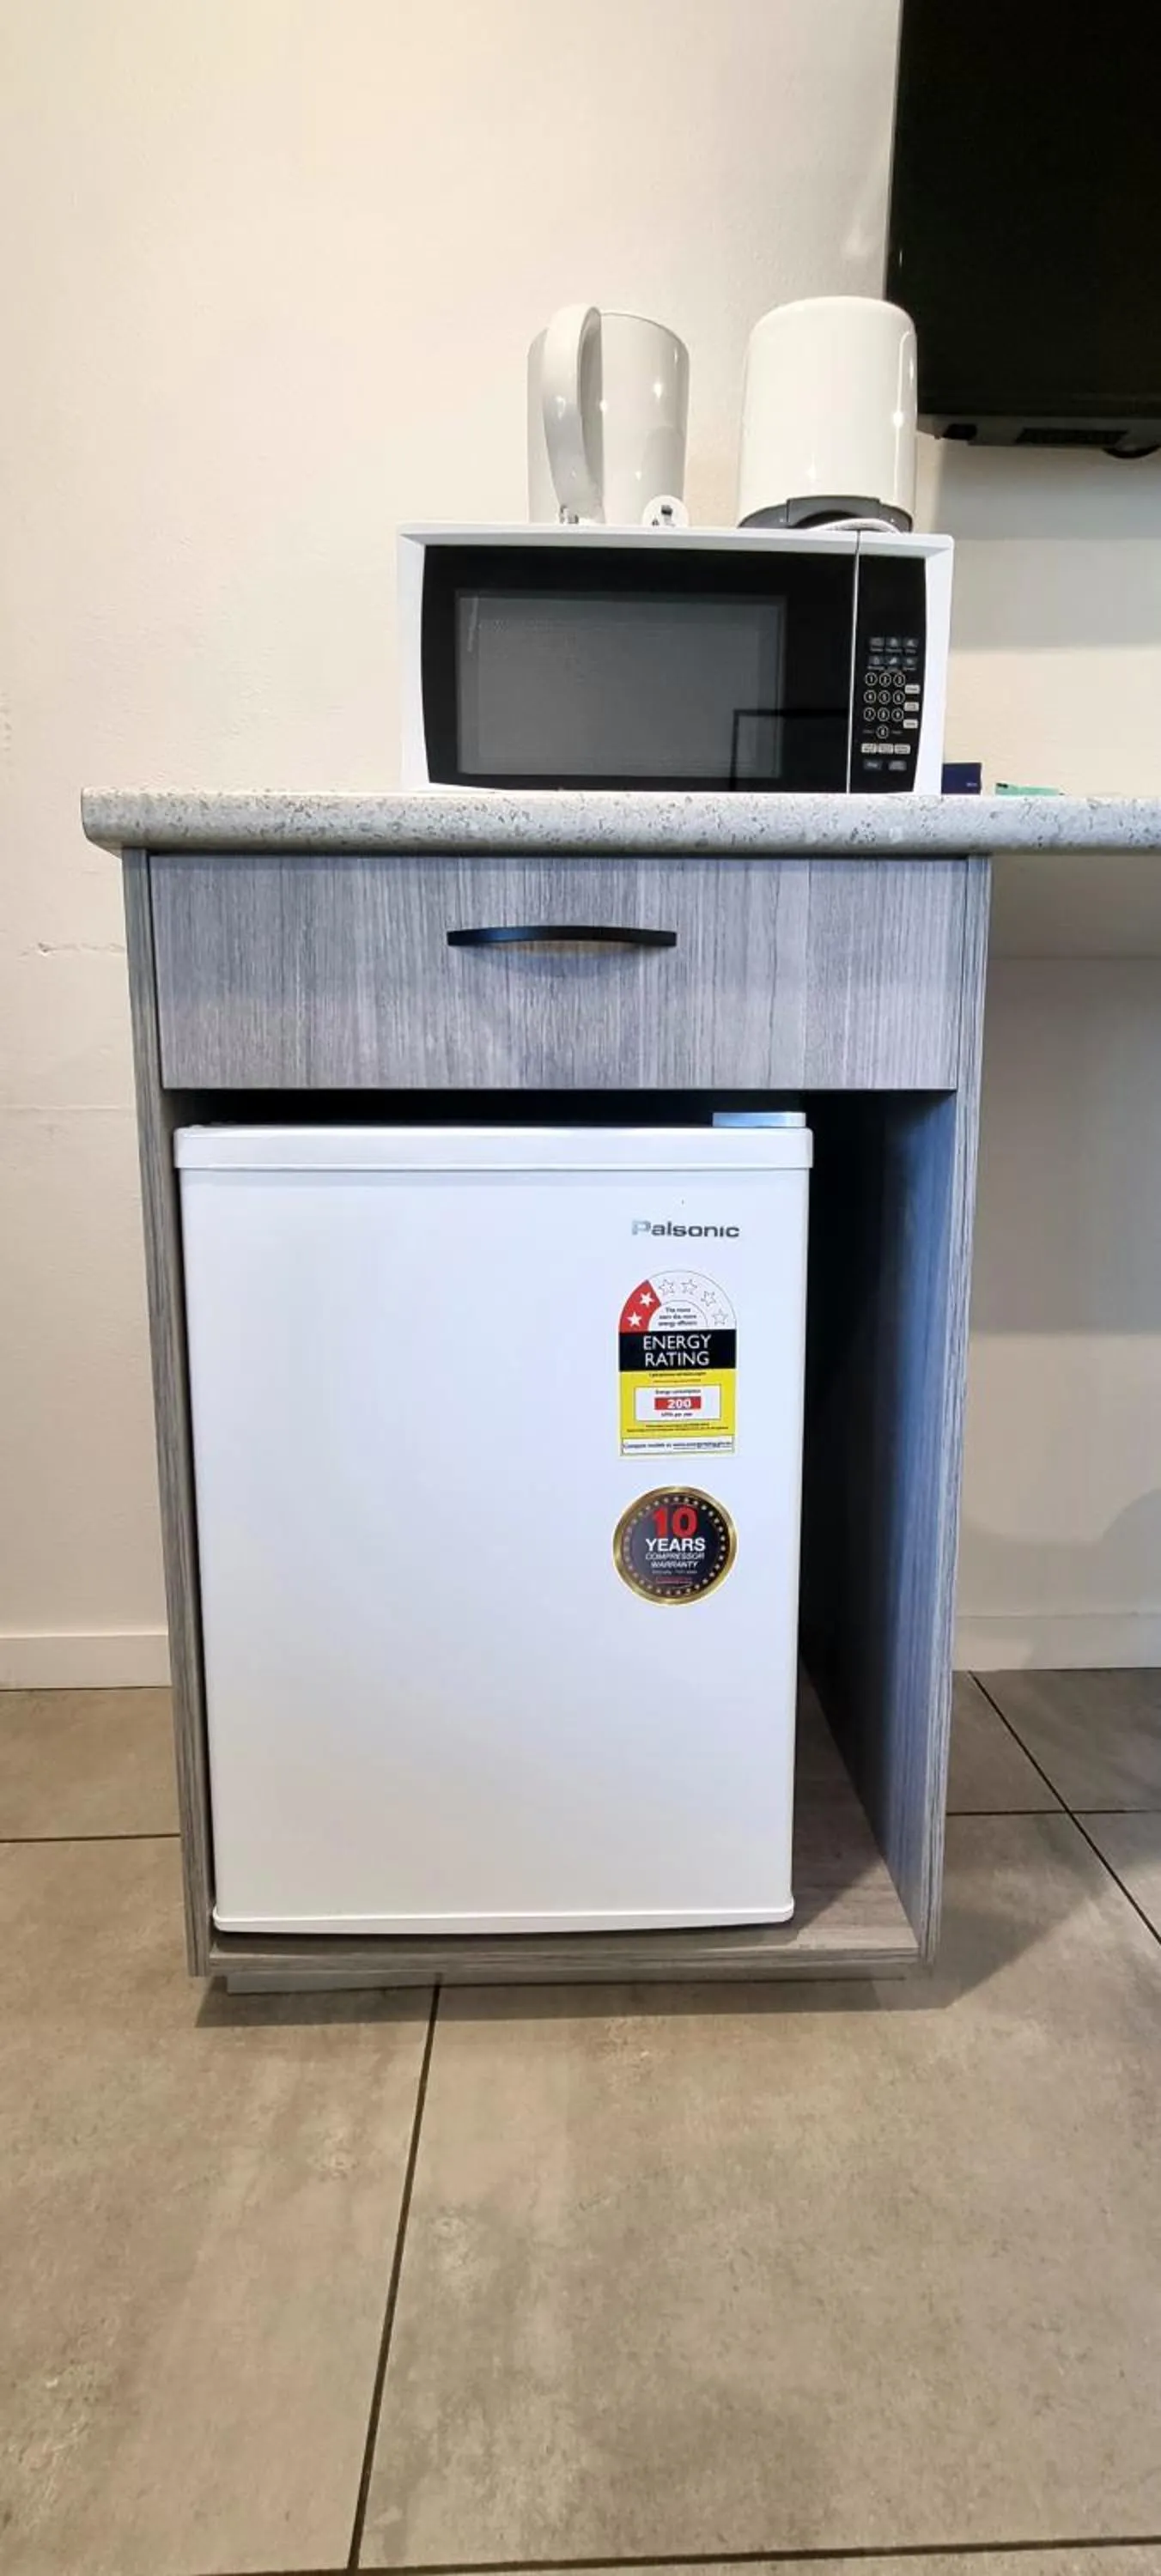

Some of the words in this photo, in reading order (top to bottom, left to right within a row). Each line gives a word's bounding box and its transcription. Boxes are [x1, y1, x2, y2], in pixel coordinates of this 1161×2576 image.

[632, 1220, 740, 1238] Palsonic
[643, 1334, 712, 1351] ENERGY
[645, 1351, 710, 1367] RATING
[667, 1399, 692, 1409] 200
[653, 1506, 698, 1539] 10
[645, 1537, 707, 1552] YEARS
[645, 1552, 706, 1560] COMPRESSOR
[651, 1559, 700, 1569] WARRANTY
